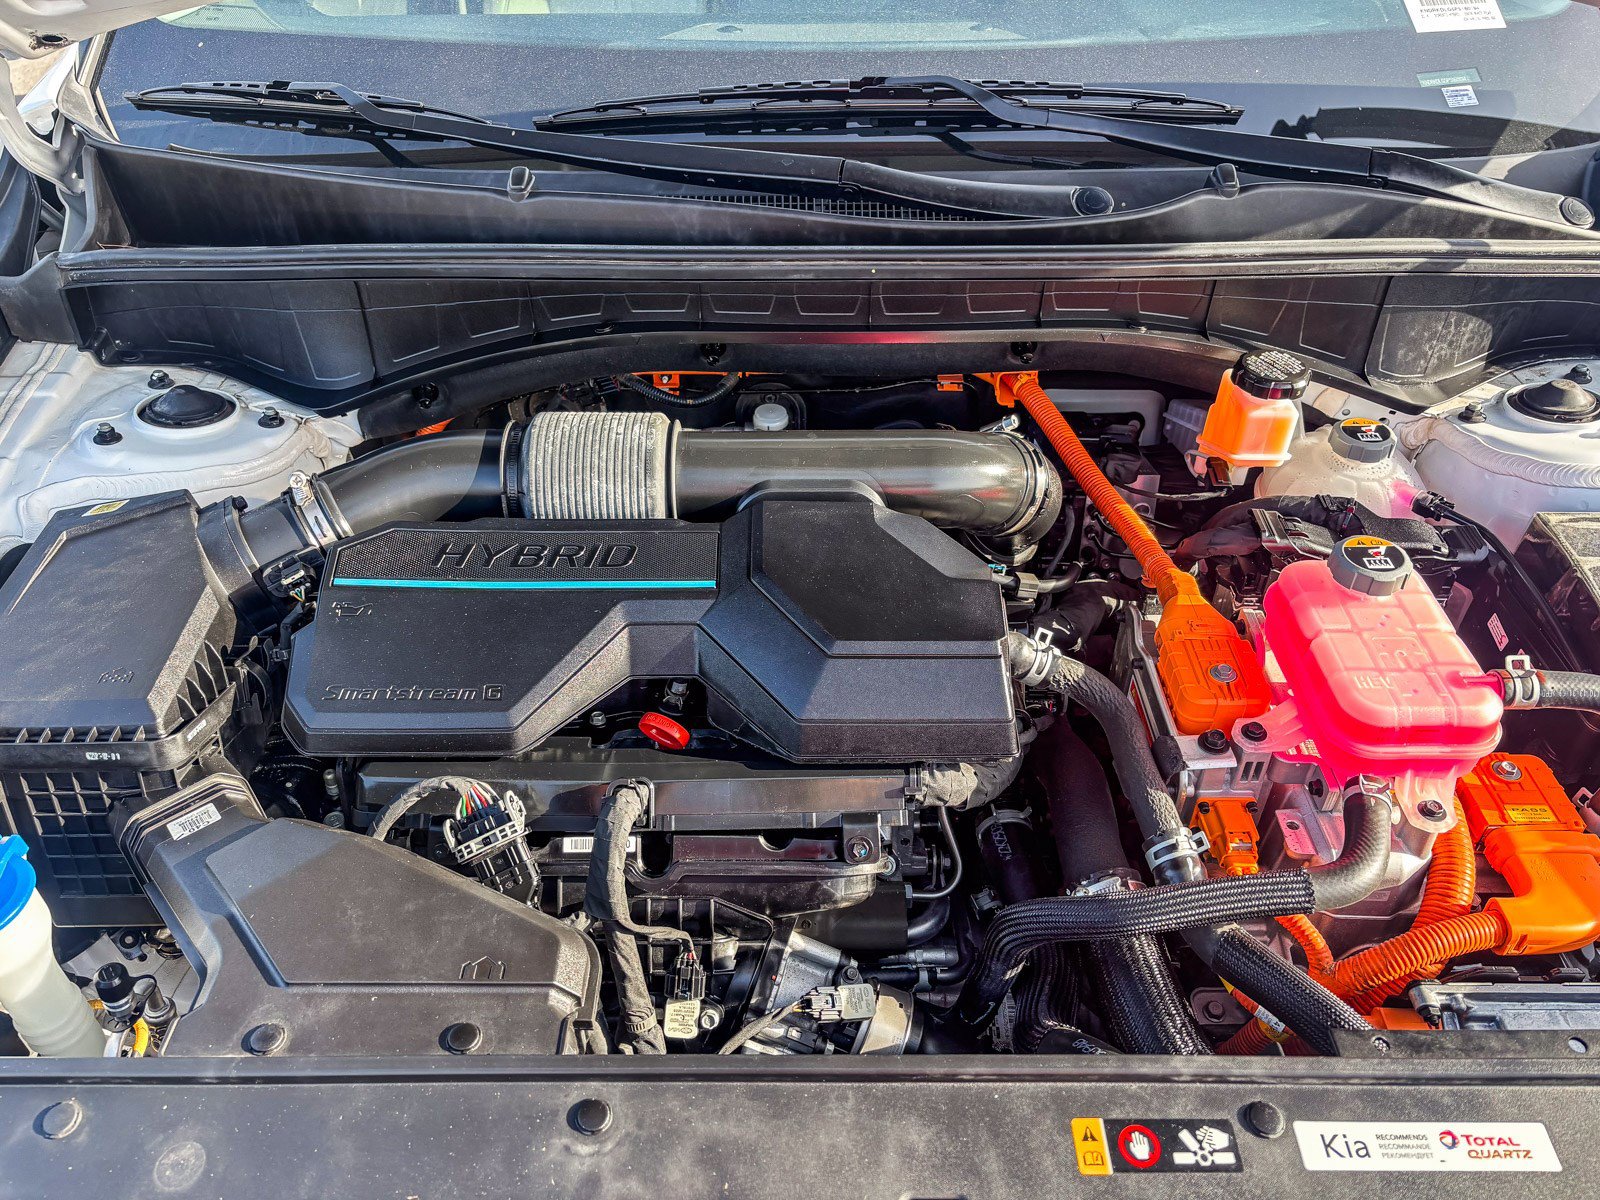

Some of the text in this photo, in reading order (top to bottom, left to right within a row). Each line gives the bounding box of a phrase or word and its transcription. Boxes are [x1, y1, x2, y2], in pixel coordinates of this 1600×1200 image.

[431, 543, 638, 569] HYBRID
[321, 683, 504, 701] Smartstream G
[1320, 1133, 1371, 1159] Kia
[1460, 1134, 1521, 1147] TOTAL
[1467, 1149, 1534, 1160] QUARTZ
